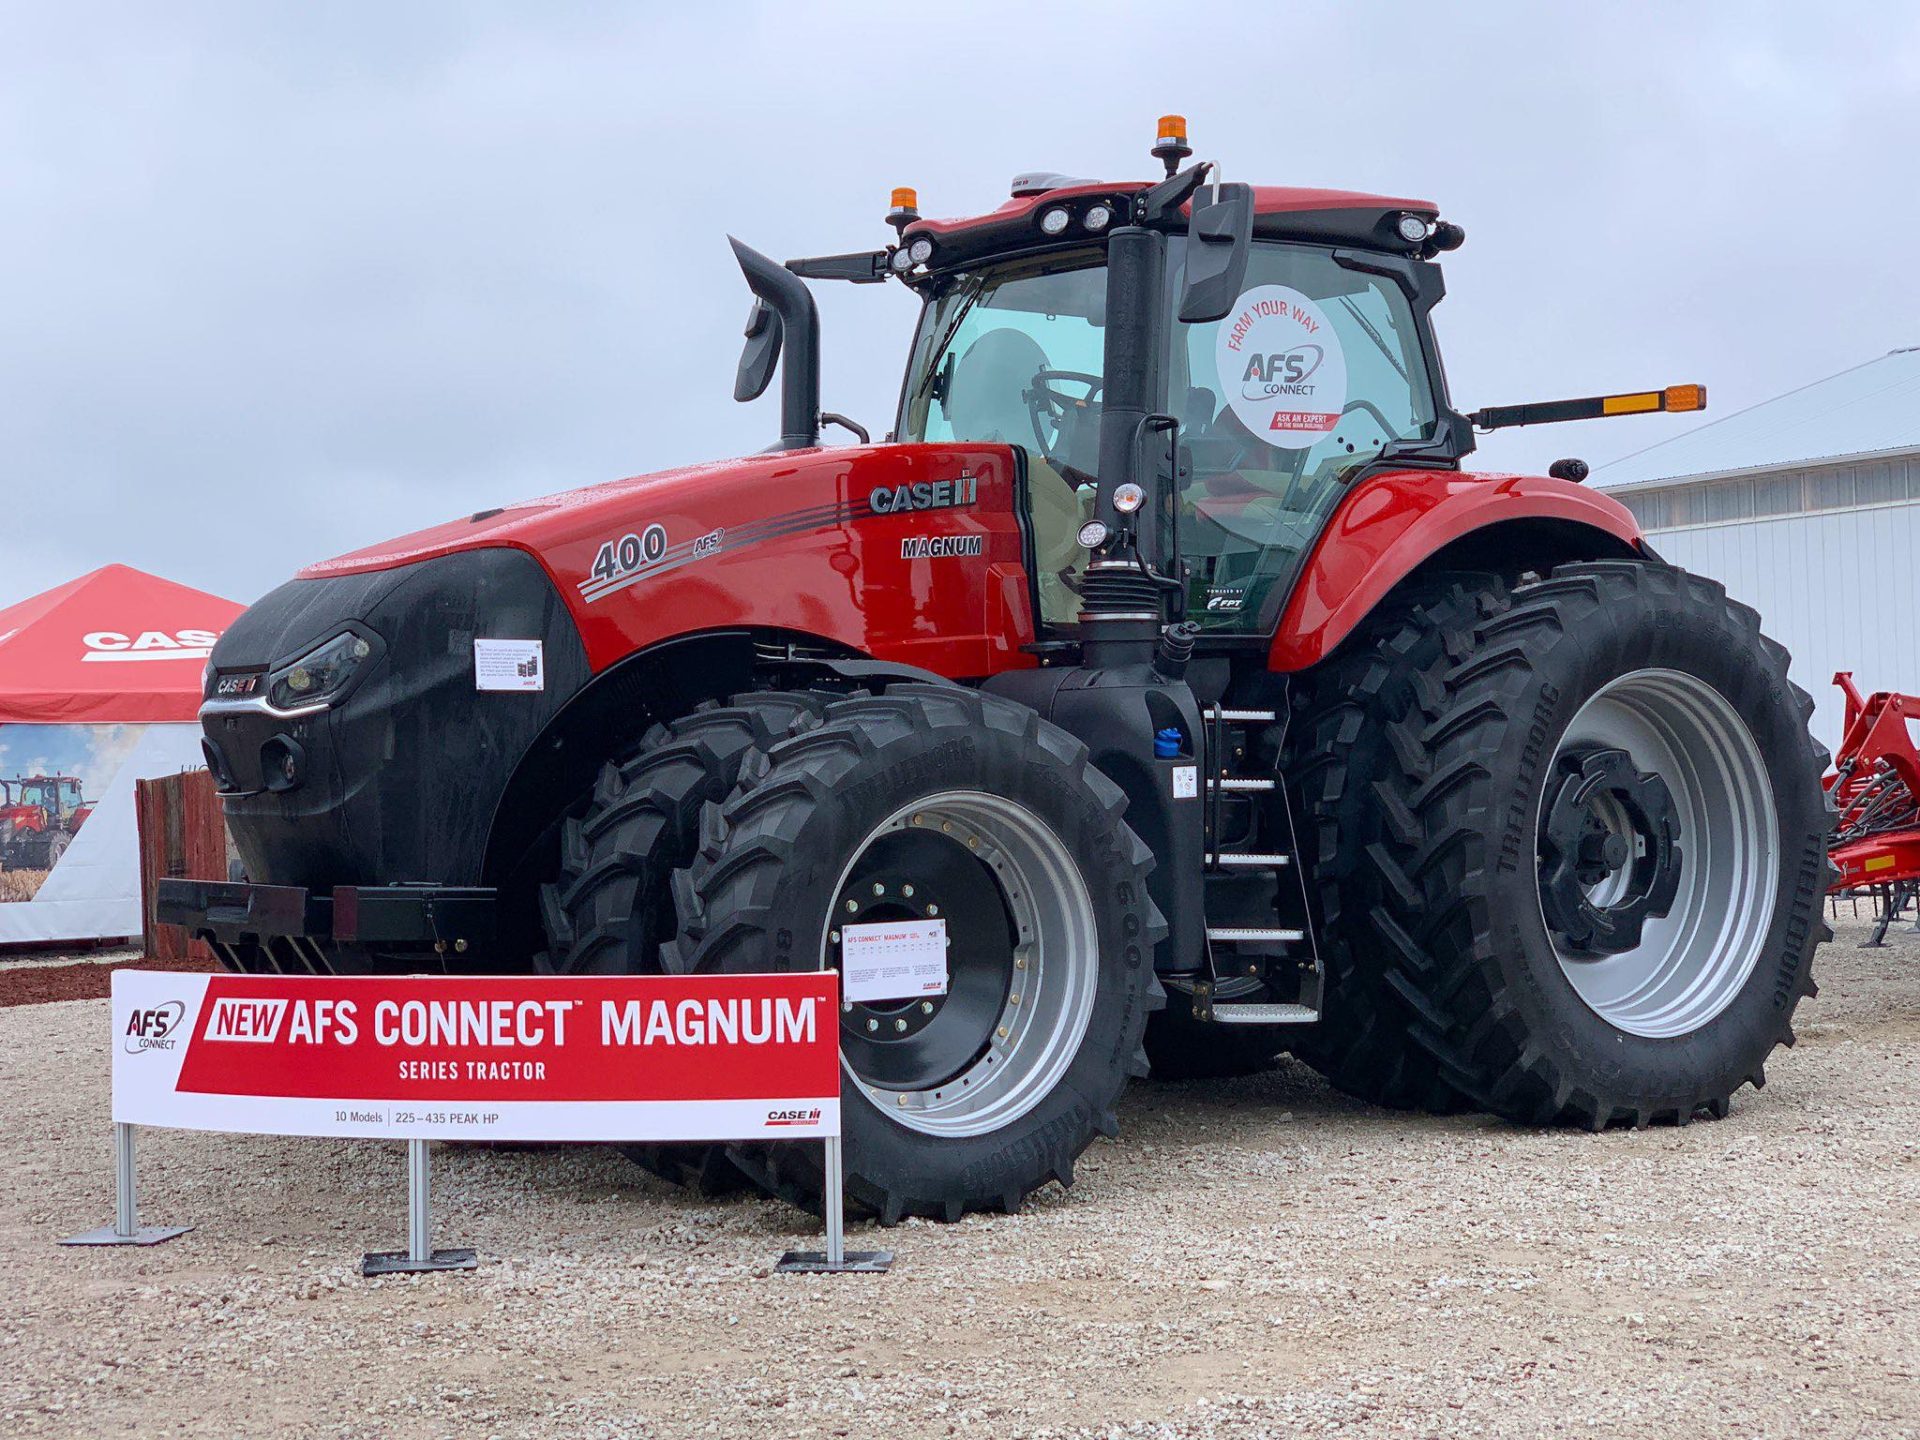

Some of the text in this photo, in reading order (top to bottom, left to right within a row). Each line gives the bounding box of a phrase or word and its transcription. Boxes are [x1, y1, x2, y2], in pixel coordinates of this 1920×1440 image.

[1228, 300, 1320, 352] FARM YOUR WAY
[1242, 353, 1304, 383] AFS
[1264, 383, 1316, 396] CONNECT
[1277, 413, 1327, 424] ASK AN EXPERT
[869, 480, 951, 514] CASE
[591, 523, 667, 580] 400
[694, 534, 718, 554] AFS
[901, 535, 982, 559] MAGNUM
[83, 630, 225, 650] CAS
[218, 679, 246, 693] CASE
[1497, 682, 1560, 874] TRELLEBORG
[1773, 832, 1823, 1011] TRELLEBORG
[126, 1009, 170, 1038] AFS
[216, 1003, 279, 1037] NEW
[288, 1000, 359, 1046] AFS
[139, 1038, 176, 1050] CONNECT
[399, 1060, 546, 1081] SERIES TRACTOR
[335, 1111, 347, 1122] 10
[350, 1111, 383, 1123] Models
[450, 1114, 479, 1124] PEAK
[483, 1114, 500, 1124] HP
[768, 1110, 807, 1120] CASE
